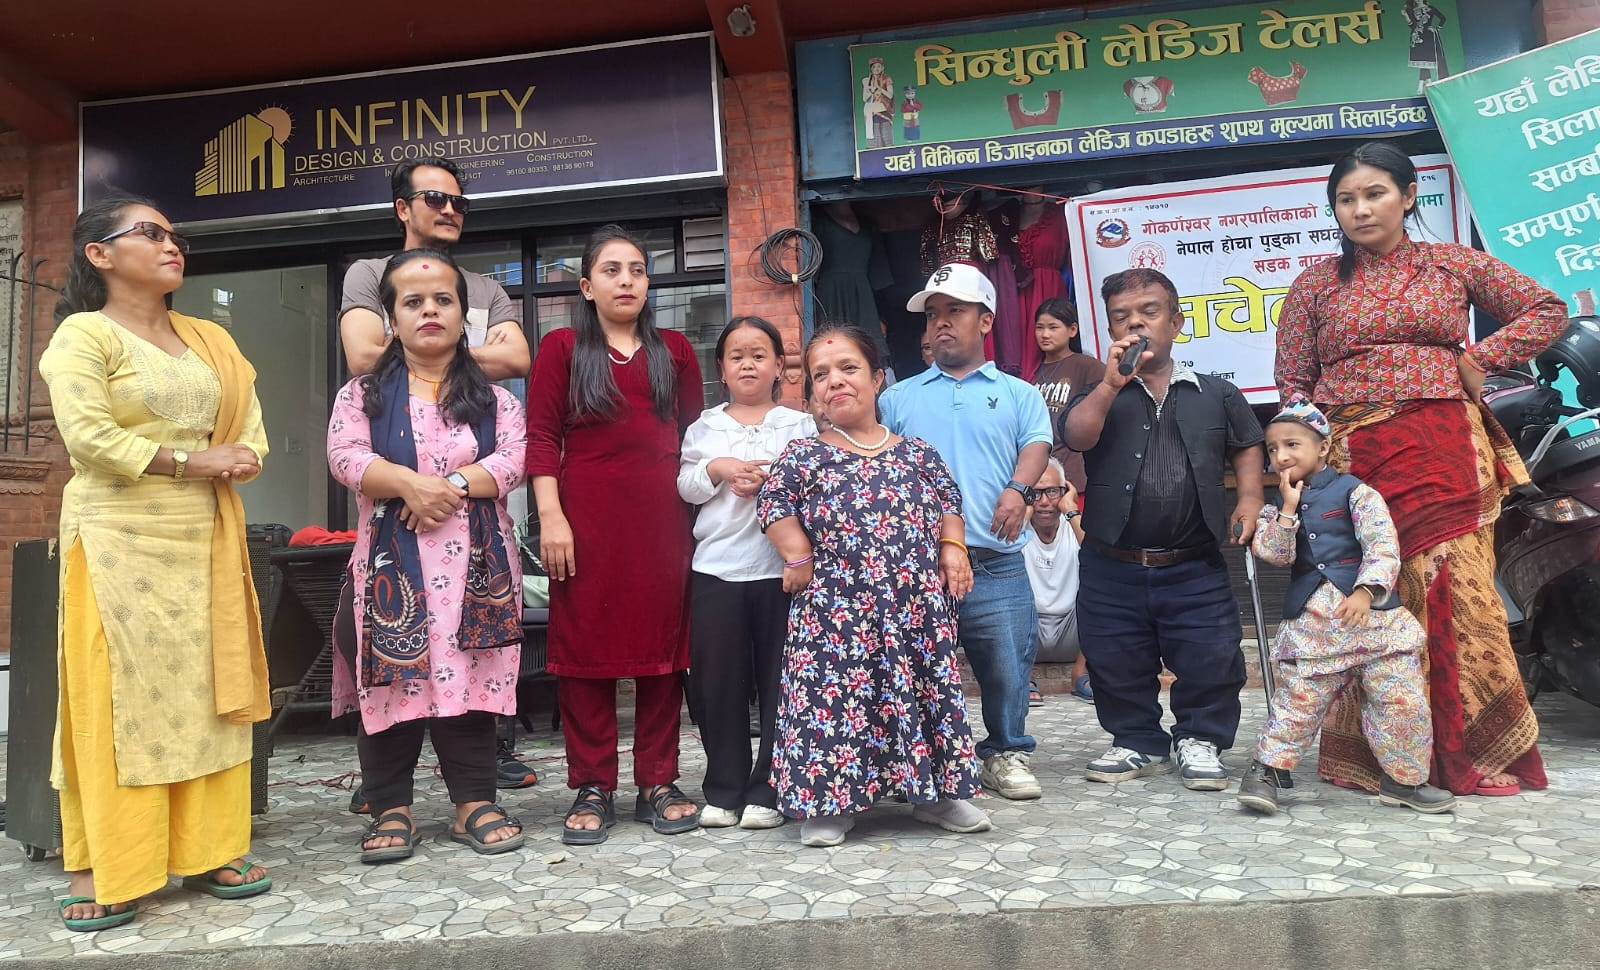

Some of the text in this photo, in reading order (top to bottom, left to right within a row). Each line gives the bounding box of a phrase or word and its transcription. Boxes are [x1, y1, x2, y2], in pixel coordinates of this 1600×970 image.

[914, 1, 1384, 88] सिन्धुली लेडिज टेलर्स
[314, 85, 537, 151] INFINITY
[1474, 76, 1539, 118] यहाँ
[294, 149, 367, 172] DESIGN
[372, 147, 385, 164] &
[389, 130, 547, 162] CONSTRUCTION
[884, 147, 917, 173] यहाँ
[921, 141, 982, 169] विभिन्न
[985, 133, 1074, 166] डिजाइनका
[1078, 131, 1134, 157] लेडिज
[1270, 112, 1335, 144] मूल्यमा
[1218, 200, 1318, 229] नगरपालिकाको
[1175, 238, 1214, 257] नेपाल
[1220, 232, 1253, 254] होचा
[1253, 256, 1291, 274] सडक
